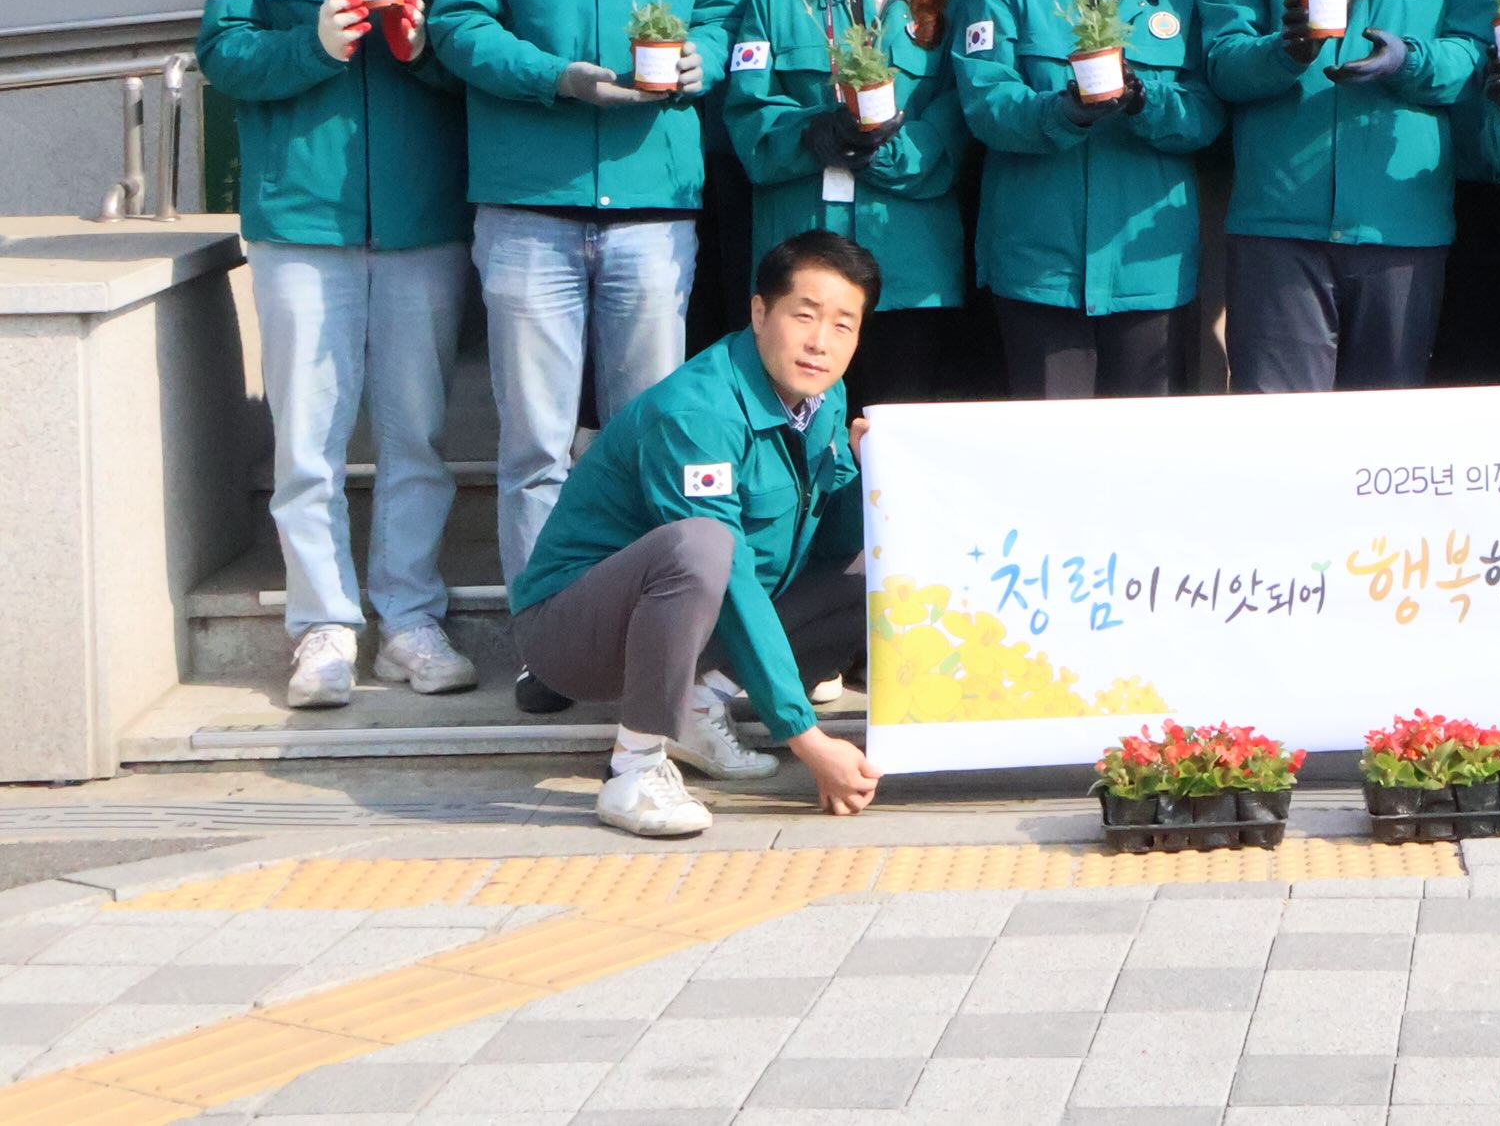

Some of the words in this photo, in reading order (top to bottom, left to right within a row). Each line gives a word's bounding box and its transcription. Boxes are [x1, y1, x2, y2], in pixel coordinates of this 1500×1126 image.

[1356, 464, 1454, 497] 2025년
[990, 527, 1161, 636] 청렴이
[1174, 560, 1333, 624] 씨앗되어
